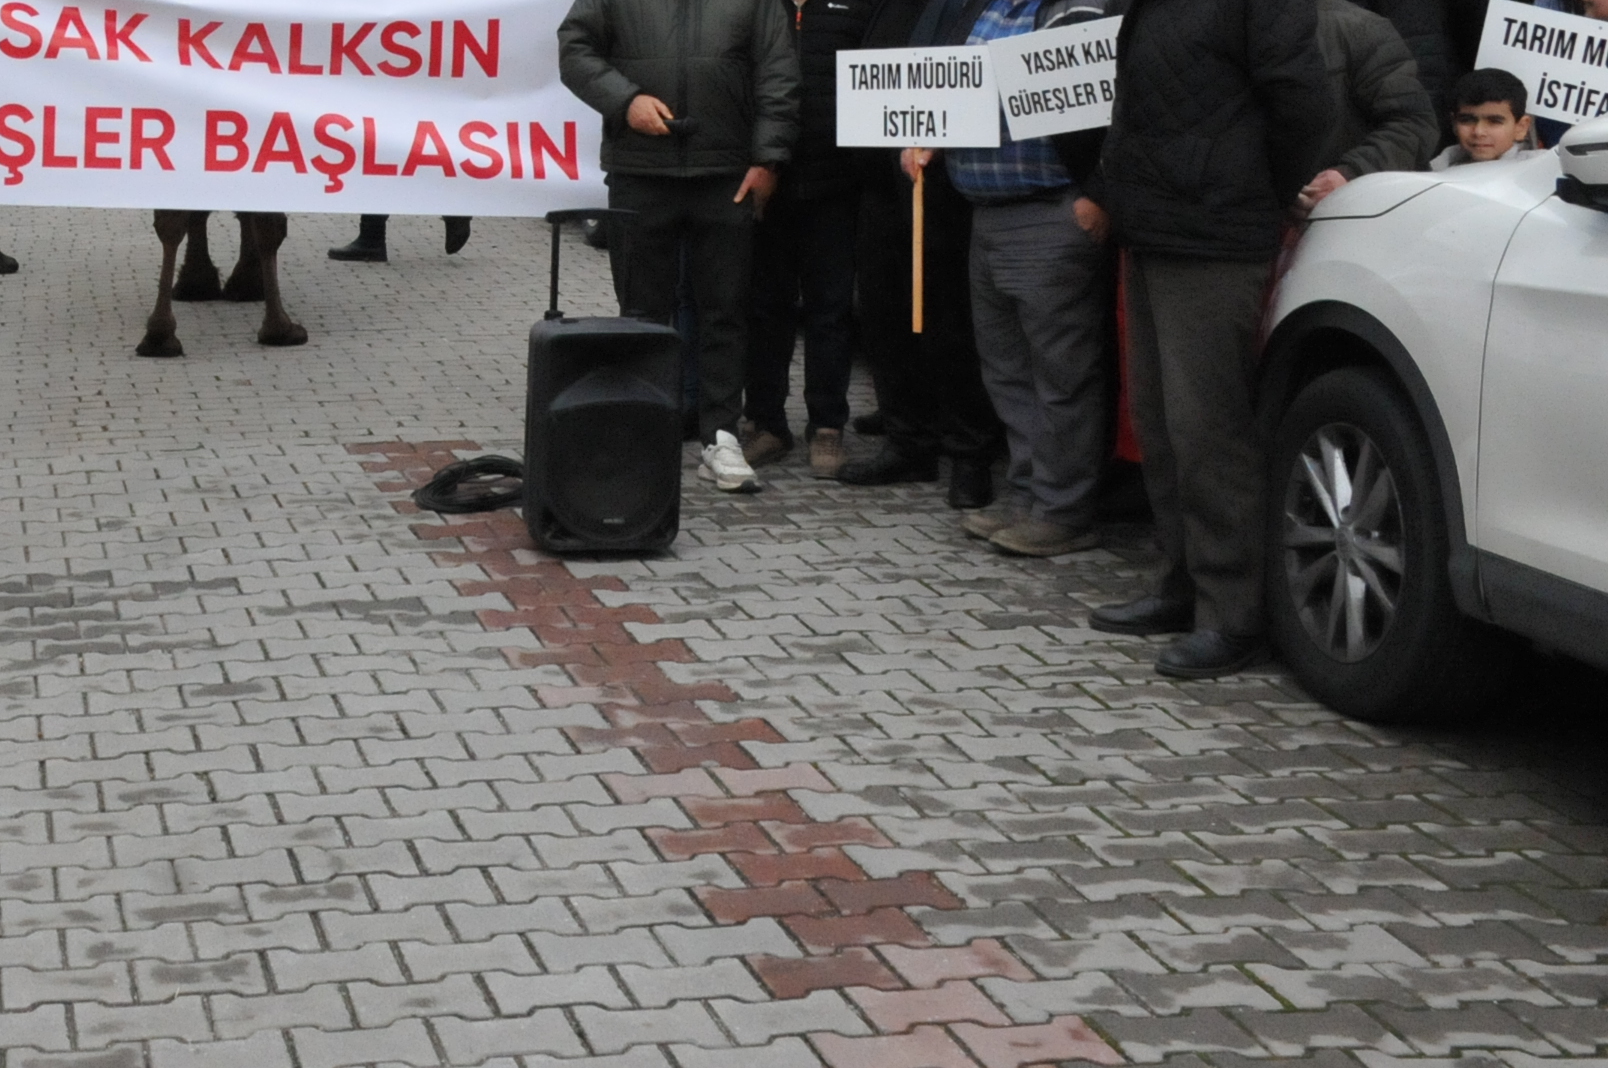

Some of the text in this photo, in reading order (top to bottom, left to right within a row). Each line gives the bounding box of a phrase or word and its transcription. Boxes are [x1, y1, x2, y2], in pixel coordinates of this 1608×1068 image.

[177, 18, 501, 79] KALKSIN
[1503, 17, 1578, 61] TARIM
[849, 56, 983, 90] TARIM MÜDÜRÜ
[1021, 44, 1081, 76] YASAK
[1007, 82, 1098, 118] GÜREŞLER
[883, 105, 947, 138] İSTİFA !
[203, 109, 579, 194] BAŞLASIN
